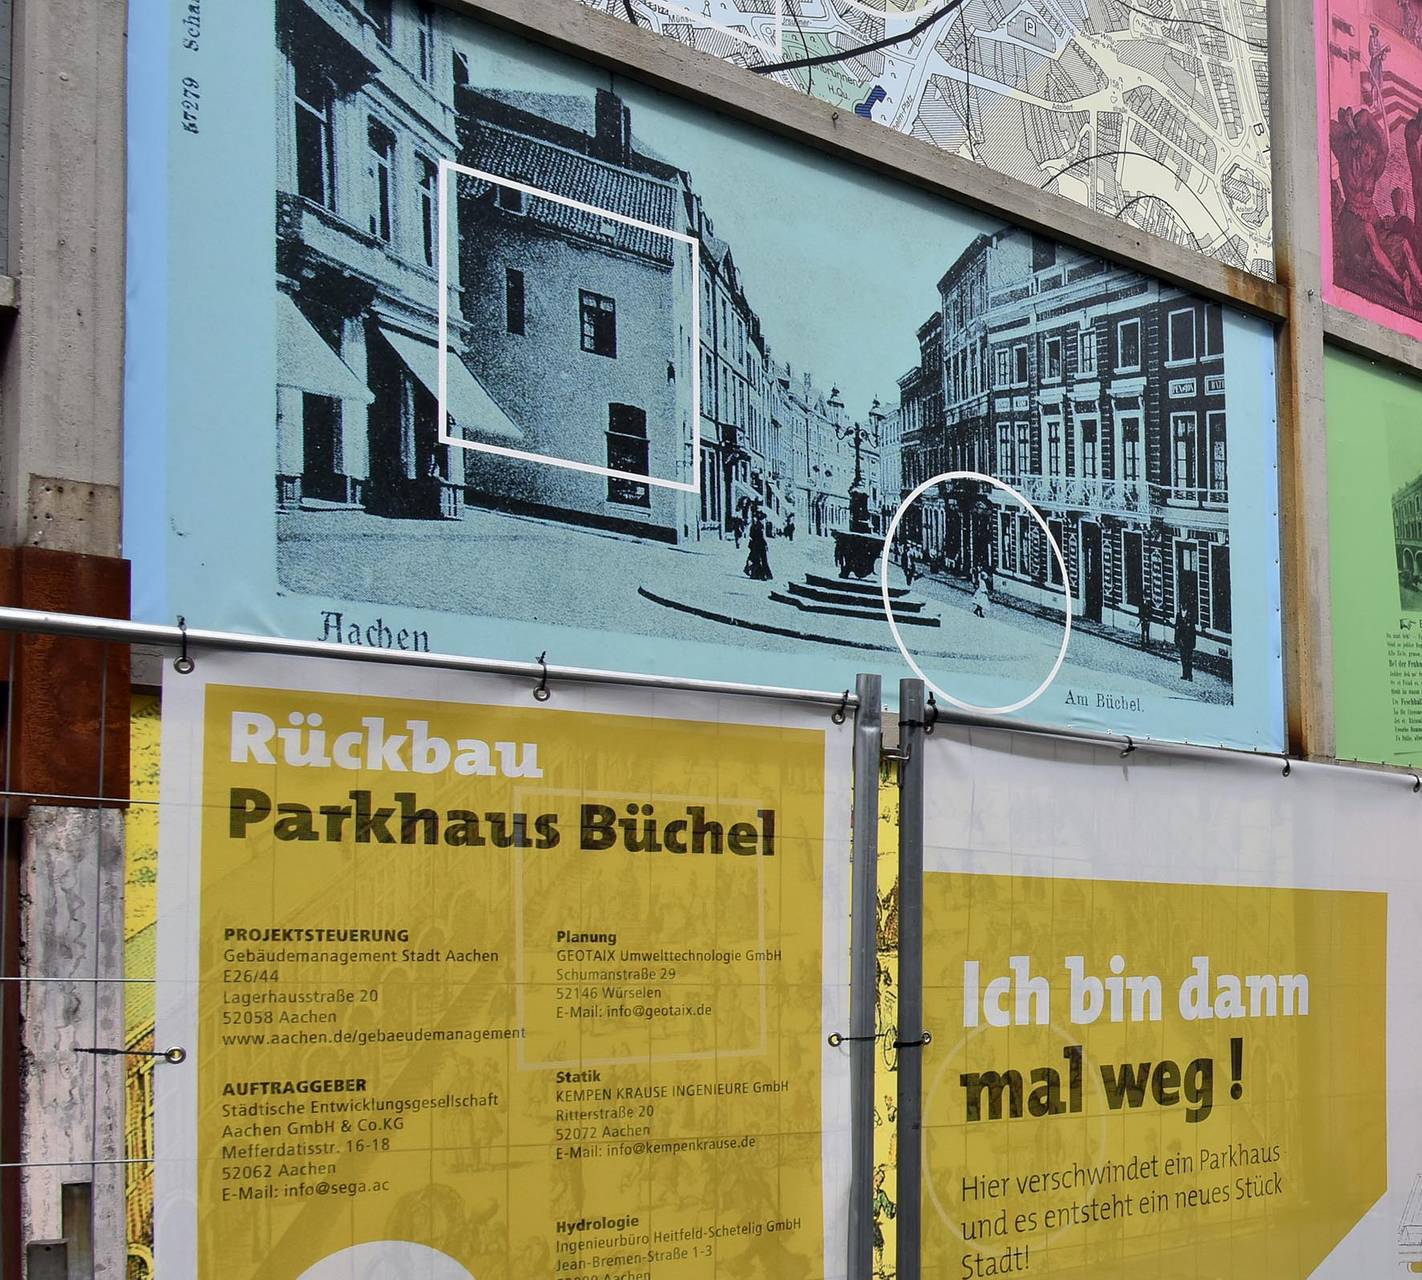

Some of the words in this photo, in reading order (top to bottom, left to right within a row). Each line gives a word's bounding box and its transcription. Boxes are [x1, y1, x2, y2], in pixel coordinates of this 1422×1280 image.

[182, 0, 201, 51] Scha
[317, 611, 430, 652] Aachen
[1065, 690, 1088, 706] Am
[230, 711, 544, 778] Rückbau
[229, 788, 561, 850] Parkhaus
[580, 803, 776, 857] Büchel
[224, 928, 409, 942] PROJEKTSTEUERUNG
[556, 930, 617, 946] Planung
[224, 949, 397, 965] Gebäudemanagement
[402, 949, 441, 962] Stadt
[445, 949, 499, 962] Aachen
[556, 950, 616, 962] GEOTAIX
[620, 949, 742, 964] Umwelttechnologie
[745, 949, 782, 961] GmbH
[223, 969, 279, 984] E26/44
[556, 968, 657, 981] Schumanstraße
[659, 968, 676, 980] 29
[223, 990, 354, 1007] Lagerhausstraße
[360, 990, 379, 1002] 20
[556, 987, 598, 1000] 52146
[601, 986, 662, 999] Würselen
[963, 955, 1050, 1028] Ich
[1065, 955, 1162, 1025] bin
[1179, 955, 1309, 1021] dann
[223, 1011, 273, 1025] 52058
[279, 1010, 337, 1024] Aachen
[556, 1005, 602, 1019] E-Mail:
[606, 1004, 712, 1020] info@geotaix.de
[222, 1027, 527, 1045] www.aachen.de/gebaeudemanagement
[222, 1078, 367, 1096] AUFTRAGGEBER
[556, 1070, 601, 1084] Statik
[959, 1045, 1083, 1122] mal
[1100, 1058, 1214, 1123] weg
[1230, 1037, 1243, 1101] !
[556, 1088, 612, 1102] KEMPEN
[616, 1085, 668, 1099] KRAUSE
[672, 1082, 749, 1098] INGENIEURE
[753, 1080, 789, 1094] GmbH
[222, 1102, 305, 1118] Städtische
[311, 1092, 498, 1115] Entwicklungsgesellschaft
[556, 1106, 634, 1122] Ritterstraße
[638, 1105, 654, 1118] 20
[222, 1123, 281, 1138] Aachen
[287, 1120, 335, 1135] GmbH
[341, 1120, 352, 1133] &
[358, 1117, 404, 1132] Co.KG
[556, 1127, 597, 1141] 52072
[602, 1125, 651, 1139] Aachen
[222, 1141, 340, 1160] Mefferdatisstr.
[346, 1138, 391, 1153] 16-18
[556, 1146, 602, 1160] E-Mail:
[607, 1136, 756, 1157] info@kempenkrause.de
[222, 1165, 272, 1180] 52062
[278, 1161, 337, 1177] Aachen
[962, 1175, 1010, 1202] Hier
[1017, 1154, 1159, 1195] verschwindet
[1164, 1152, 1193, 1176] ein
[1200, 1143, 1281, 1171] Parkhaus
[222, 1185, 279, 1201] E-Mail:
[284, 1179, 390, 1198] info@sega.ac
[961, 1209, 1008, 1241] und
[1015, 1211, 1037, 1233] es
[1044, 1194, 1133, 1229] entsteht
[1139, 1190, 1169, 1214] ein
[1176, 1185, 1230, 1209] neues
[1235, 1172, 1283, 1200] Stück
[556, 1215, 640, 1235] Hydrologie
[556, 1234, 650, 1254] Ingenieurbüro
[653, 1221, 763, 1244] Heitfeld-Schetelig
[766, 1217, 802, 1232] GmbH
[556, 1248, 689, 1272] Jean-Bremen-Straße
[692, 1245, 713, 1259] 1-3
[962, 1245, 1030, 1280] Stadt!
